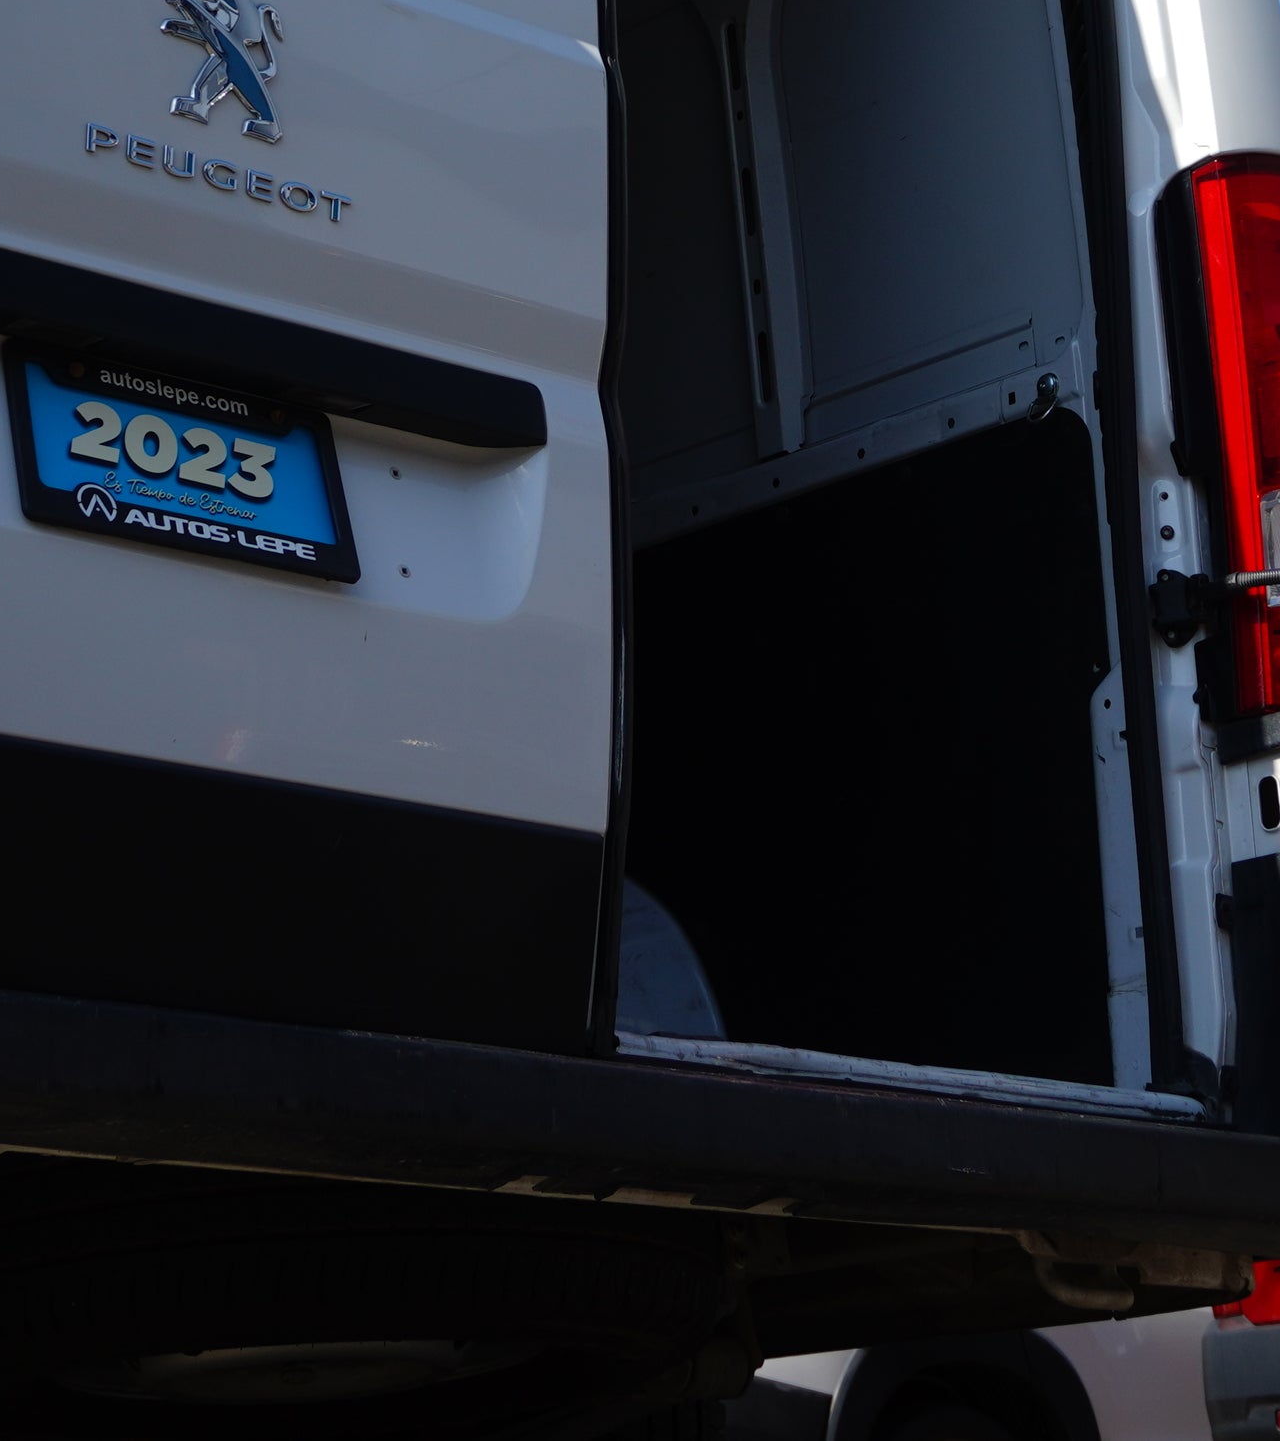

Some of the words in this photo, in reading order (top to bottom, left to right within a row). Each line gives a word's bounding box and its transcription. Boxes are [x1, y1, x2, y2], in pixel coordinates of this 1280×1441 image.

[85, 122, 352, 223] PEUGEOT
[100, 369, 249, 416] autoslepe.com
[70, 400, 277, 500] 2023
[126, 477, 175, 501] Tiempo
[179, 491, 197, 507] de
